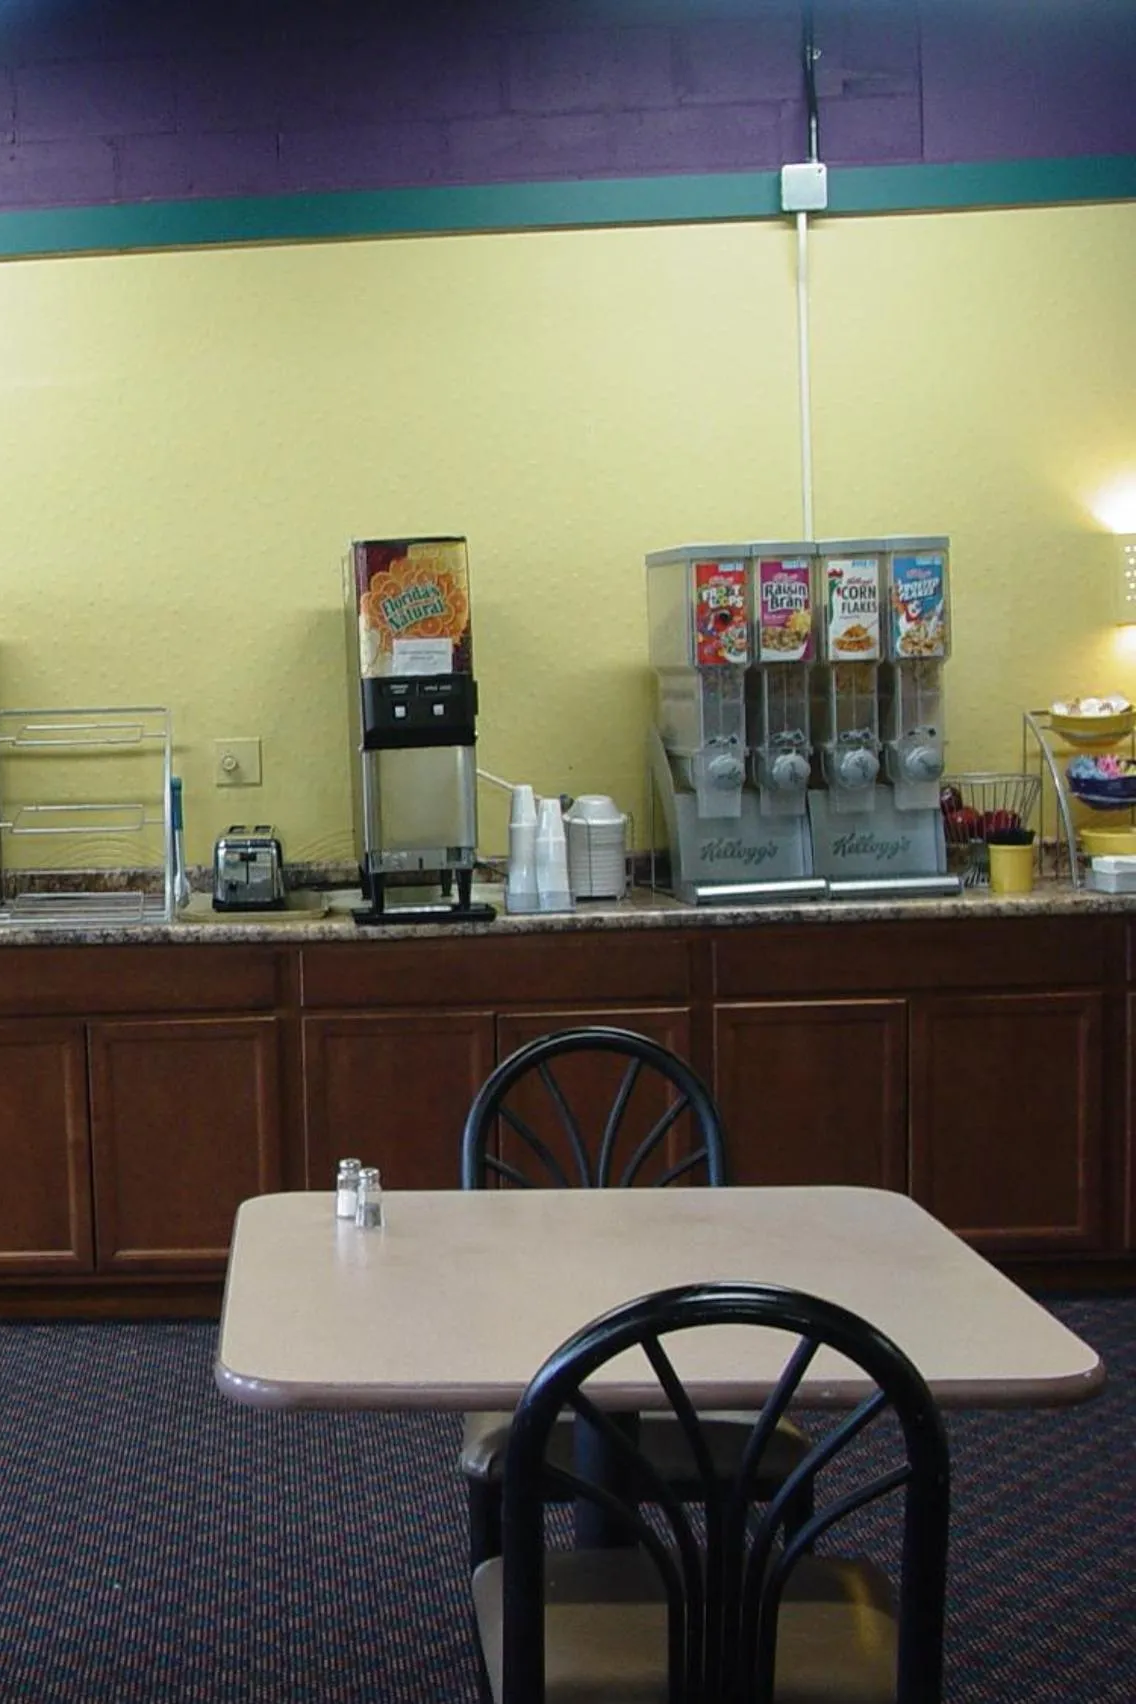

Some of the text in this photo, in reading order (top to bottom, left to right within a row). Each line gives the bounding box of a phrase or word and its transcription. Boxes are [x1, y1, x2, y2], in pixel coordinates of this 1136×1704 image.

[764, 583, 806, 598] Raisin
[841, 586, 876, 600] CORN
[770, 597, 802, 611] Bran
[841, 601, 877, 614] FLAKES
[699, 837, 779, 866] Kellogg's
[831, 833, 912, 861] Kellogg's
